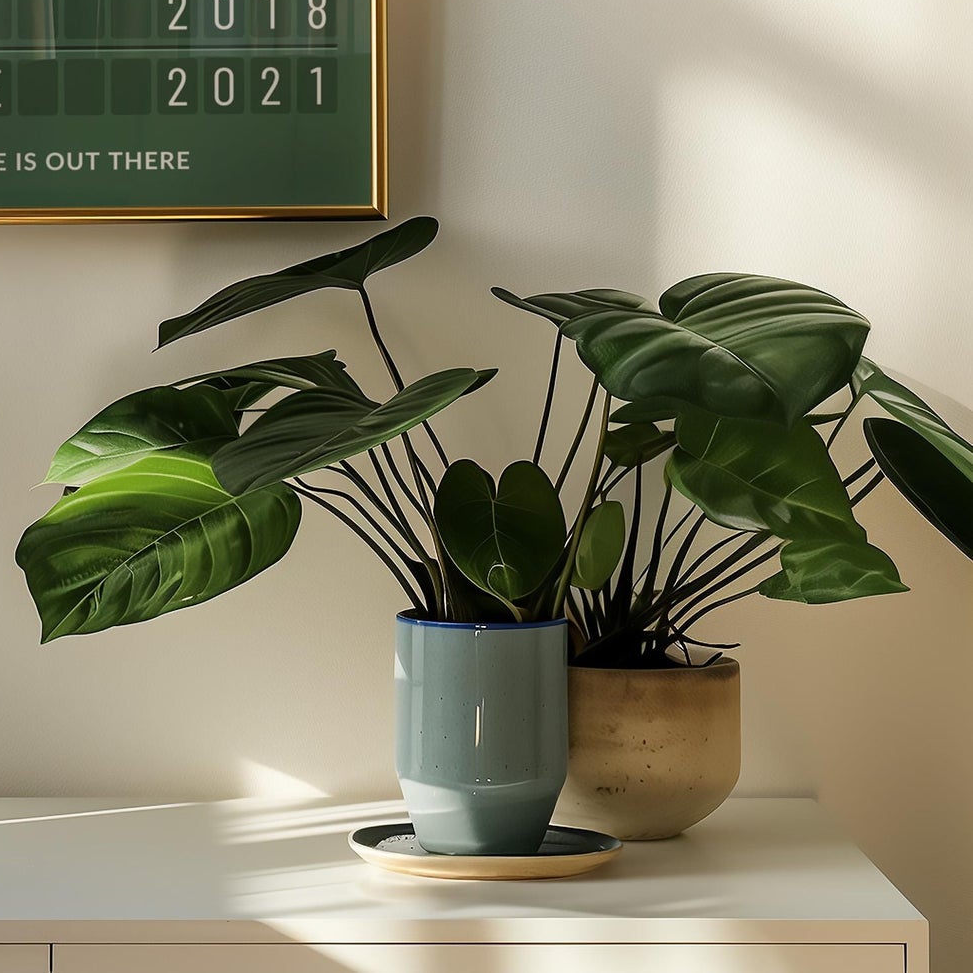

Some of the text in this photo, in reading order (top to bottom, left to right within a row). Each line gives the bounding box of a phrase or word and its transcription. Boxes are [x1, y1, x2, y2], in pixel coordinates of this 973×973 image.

[168, 67, 321, 106] 2021
[17, 153, 36, 171] IS
[46, 152, 100, 170] OUT
[108, 151, 189, 170] THERE
